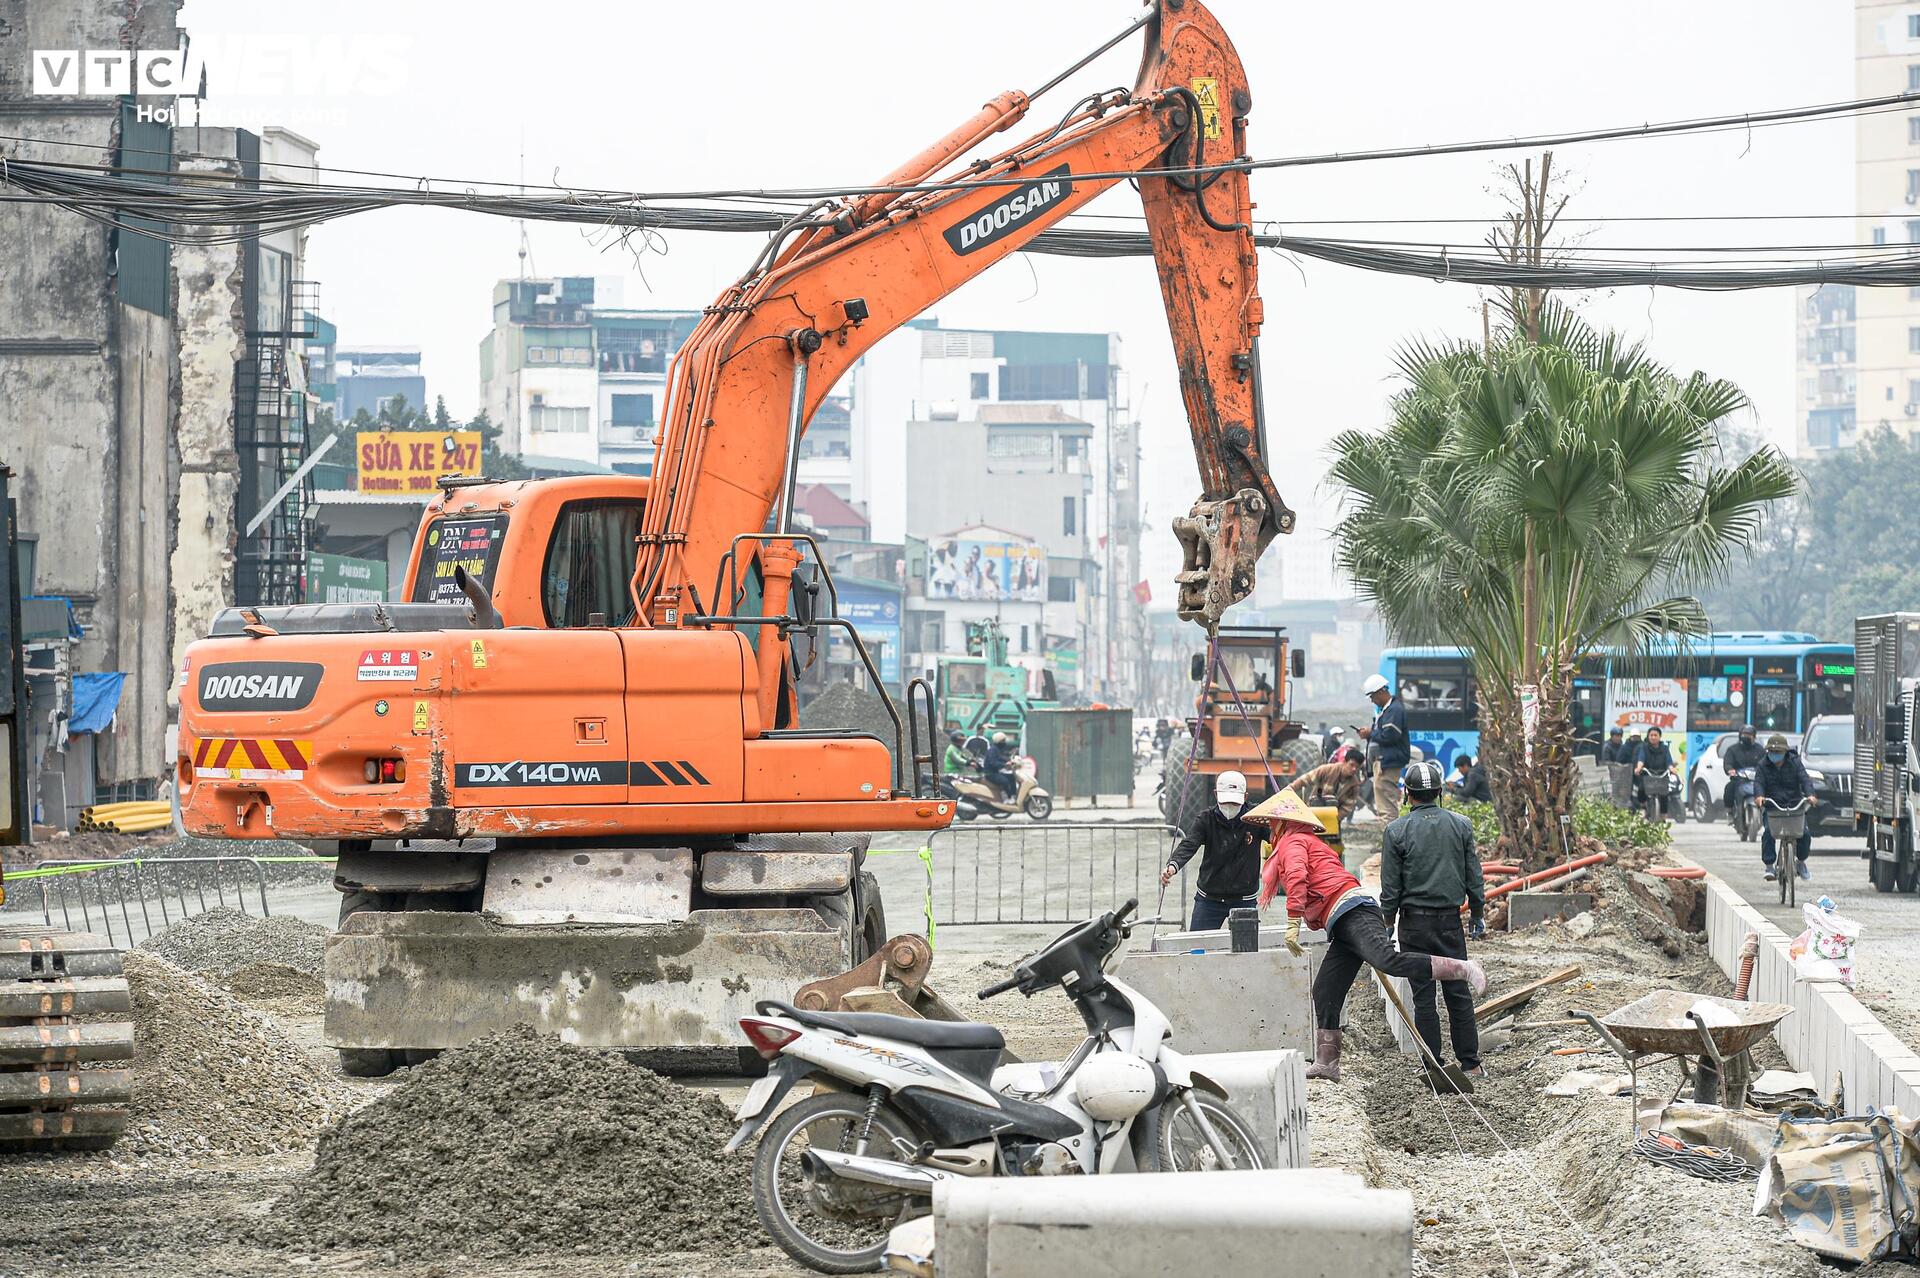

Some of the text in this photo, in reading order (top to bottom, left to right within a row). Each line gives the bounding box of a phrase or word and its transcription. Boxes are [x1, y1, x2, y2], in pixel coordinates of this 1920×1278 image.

[960, 180, 1061, 249] DOOSAN
[362, 434, 478, 471] SỬA XE 247
[203, 675, 304, 700] DOOSAN
[1615, 700, 1639, 709] KHAI
[1628, 712, 1663, 726] 08.11
